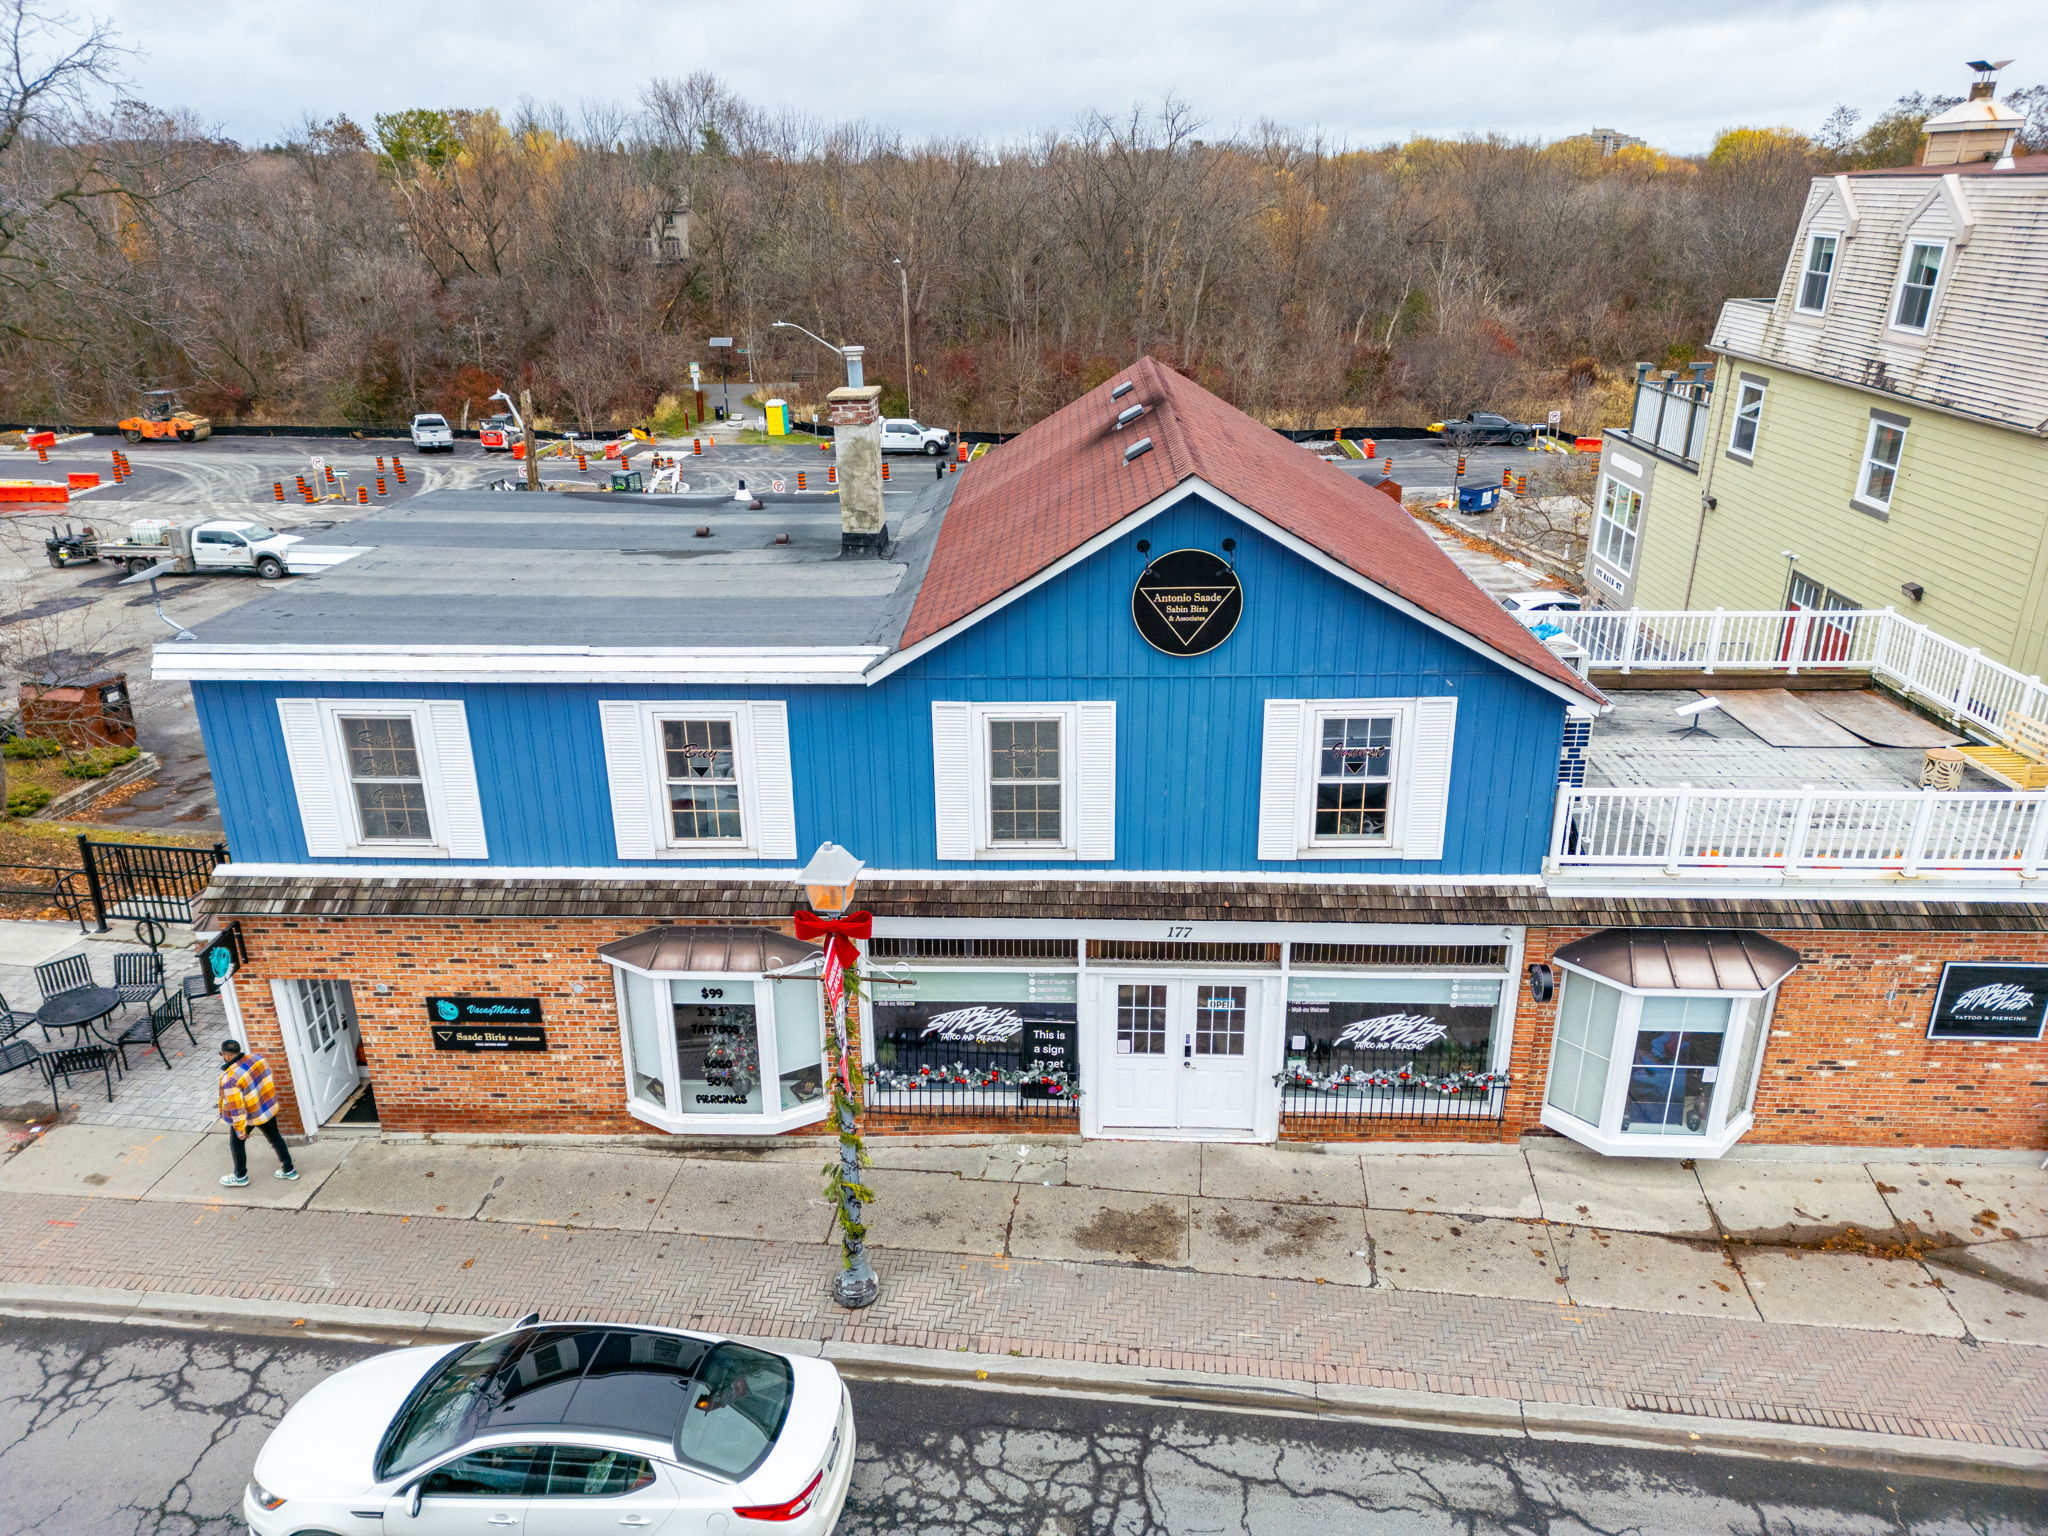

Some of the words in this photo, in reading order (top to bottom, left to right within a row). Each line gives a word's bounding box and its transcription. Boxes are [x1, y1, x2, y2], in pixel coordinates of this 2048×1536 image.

[1153, 593, 1192, 603] Antonio
[1194, 592, 1222, 602] Saade
[1166, 605, 1189, 613] Sabin
[1190, 605, 1209, 613] Biris
[357, 729, 401, 746] Real
[683, 743, 719, 762] Buy
[1006, 743, 1045, 760] Sell
[1167, 926, 1193, 938] 177
[701, 987, 724, 1000] $99
[1209, 1000, 1233, 1009] OPEN
[466, 1004, 531, 1016] VacayMode.ca
[690, 1024, 740, 1034] TATTOOS
[456, 1032, 483, 1041] Saade
[484, 1032, 506, 1041] Biris
[940, 1033, 961, 1042] TATTOO
[961, 1034, 975, 1042] AND
[976, 1034, 1008, 1043] PIERCING
[1033, 1030, 1055, 1040] This
[1056, 1030, 1066, 1040] is
[1043, 1044, 1065, 1056] sign
[1354, 1041, 1375, 1050] TATTOO
[1375, 1042, 1390, 1050] AND
[1390, 1042, 1425, 1051] PIERCING
[704, 1059, 733, 1069] BOGO
[707, 1077, 733, 1087] 50%
